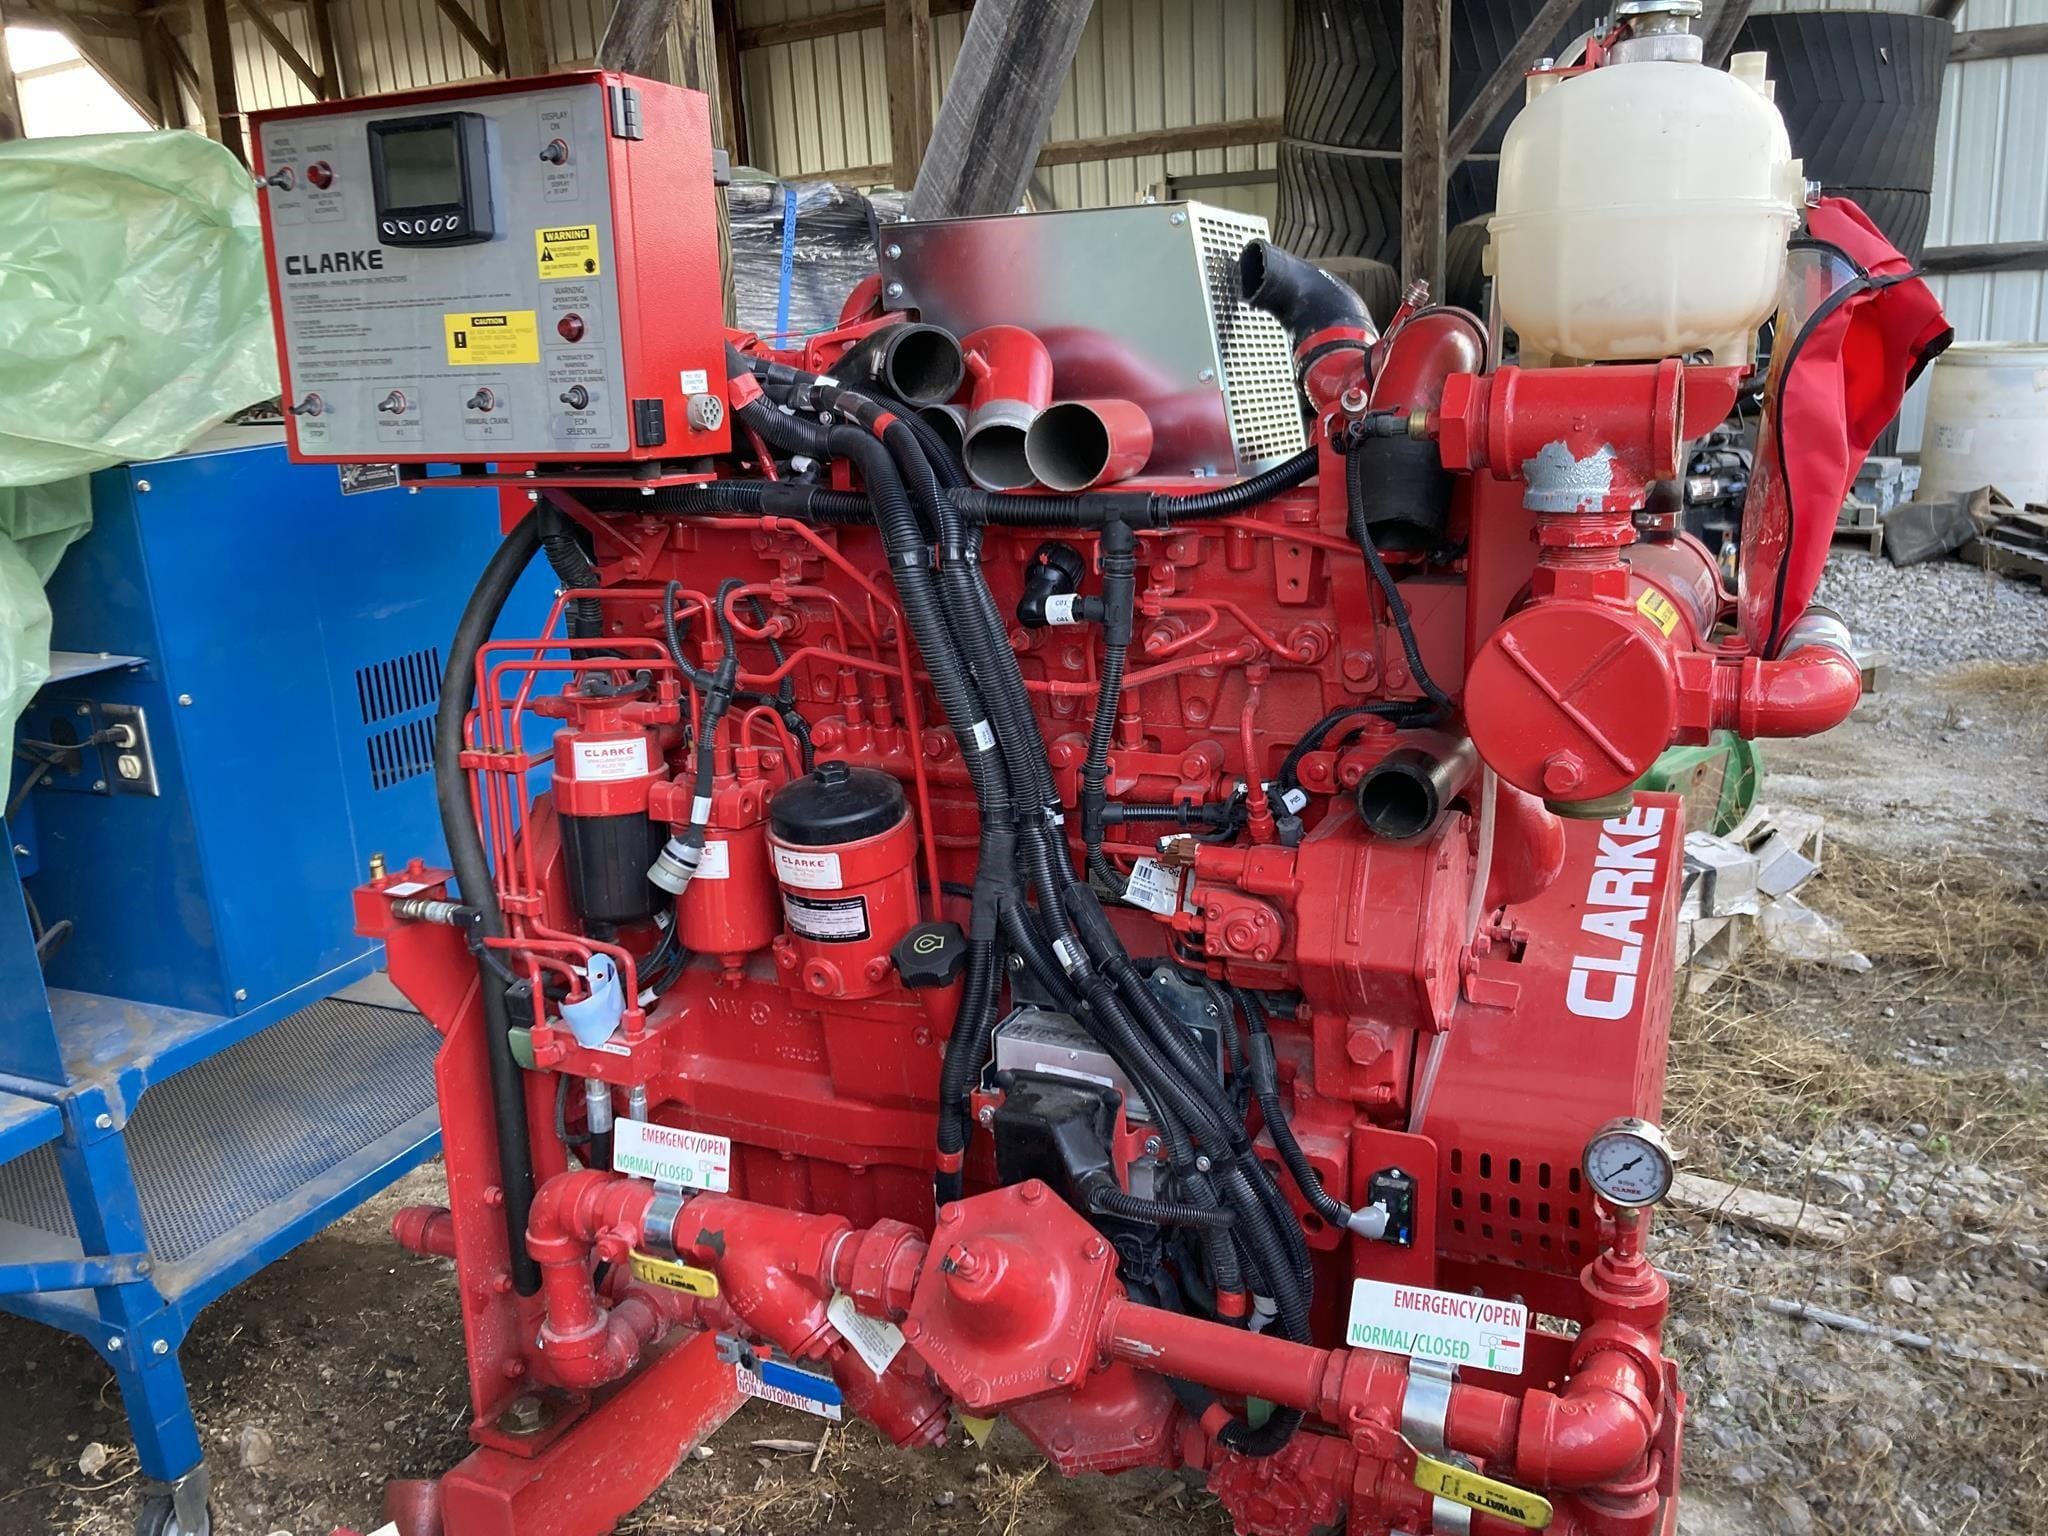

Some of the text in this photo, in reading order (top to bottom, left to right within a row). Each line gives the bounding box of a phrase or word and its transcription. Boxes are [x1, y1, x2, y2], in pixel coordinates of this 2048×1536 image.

[545, 230, 588, 241] WARNING
[285, 249, 384, 276] CLARKE
[473, 317, 505, 326] CAUTION
[566, 427, 598, 435] SELECTOR
[584, 747, 634, 757] CLARKE
[781, 855, 825, 868] CLARKE
[1565, 806, 1665, 1020] CLARKE
[641, 1127, 727, 1156] EMERGENCY/OPEN
[616, 1153, 693, 1182] NORMAL/CLOSED
[1394, 1289, 1522, 1328] EMERGENCY/OPEN
[1351, 1322, 1470, 1360] NORMAL/CLOSED
[739, 1379, 811, 1411] NON-AUTOMATIC
[1466, 1491, 1526, 1520] WATTS
